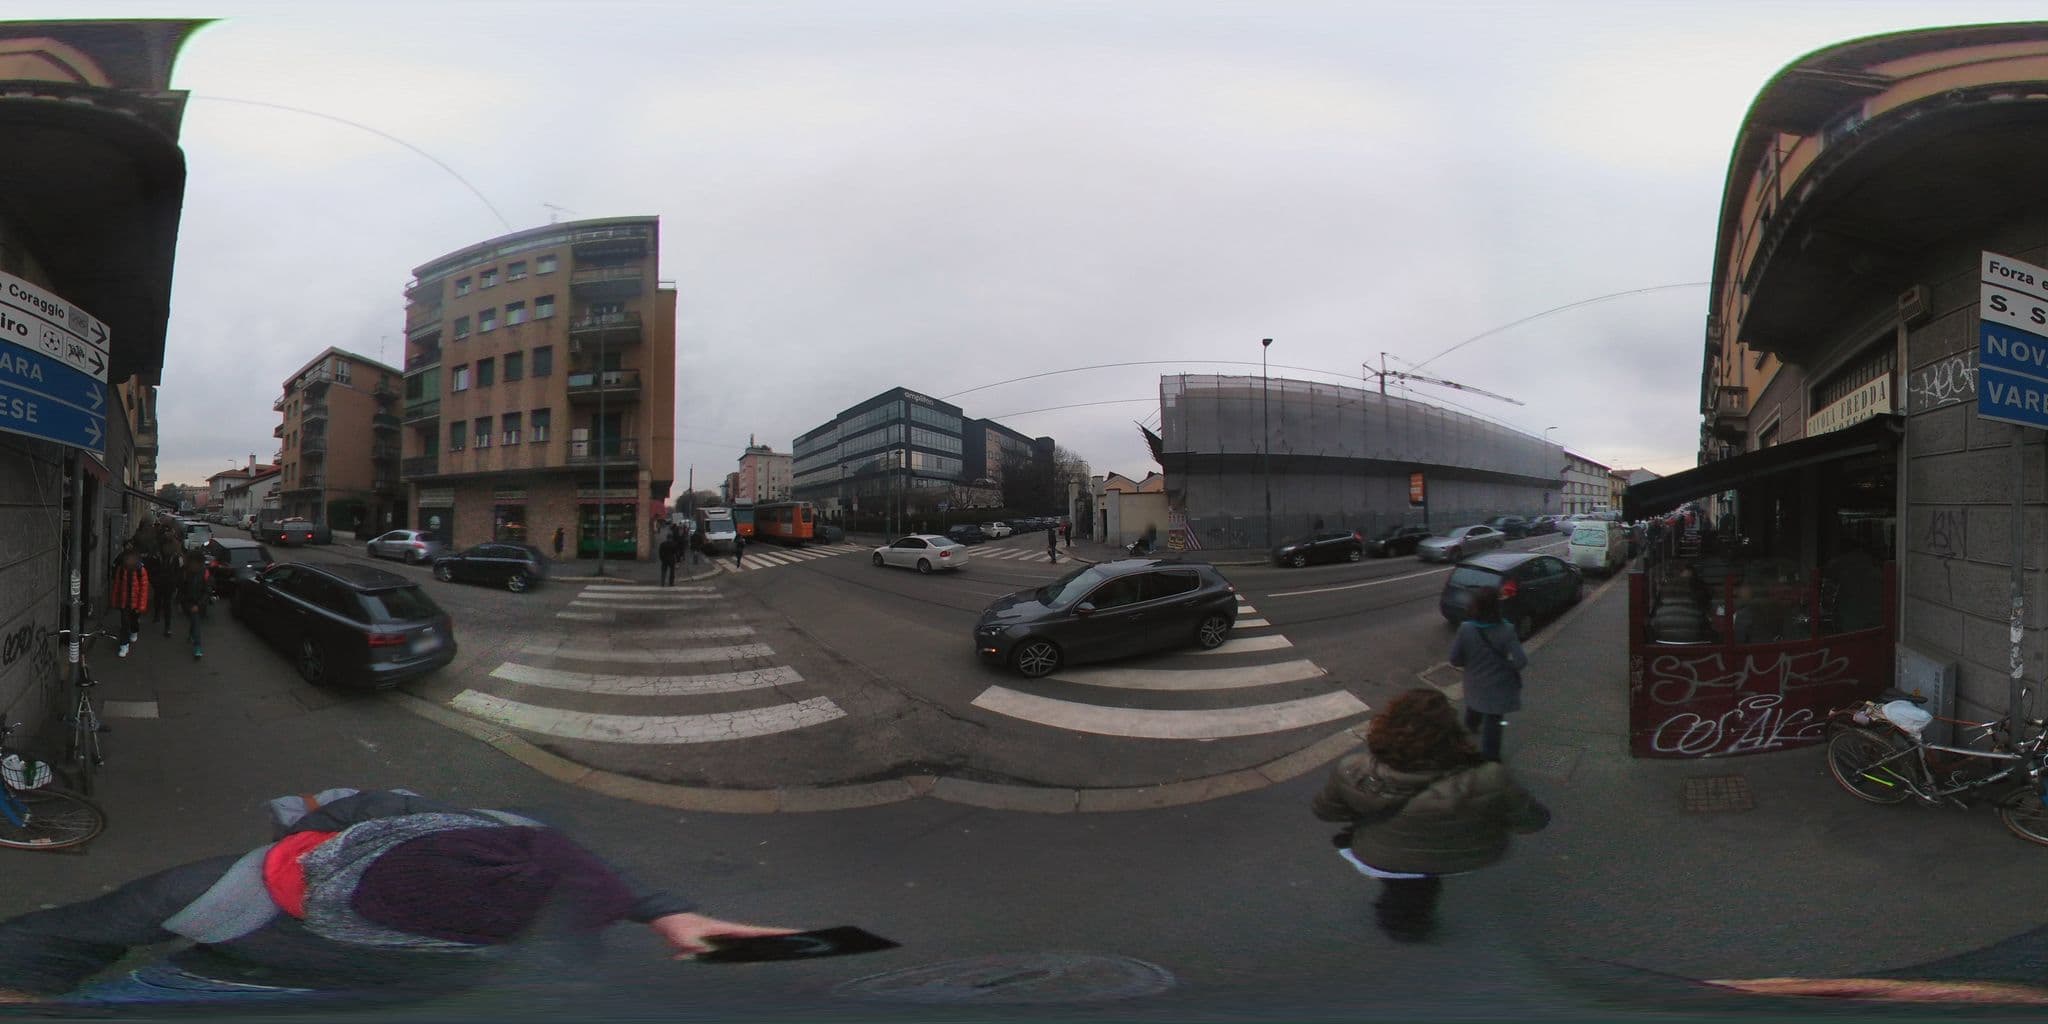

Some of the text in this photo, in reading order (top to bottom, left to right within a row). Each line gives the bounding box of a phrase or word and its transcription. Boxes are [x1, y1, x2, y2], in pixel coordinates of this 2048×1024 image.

[1989, 260, 2034, 286] Forza
[9, 283, 66, 319] Coraggio
[1989, 294, 2016, 317] S.
[1987, 334, 2048, 368] NOV
[1841, 380, 1886, 420] FREDDA
